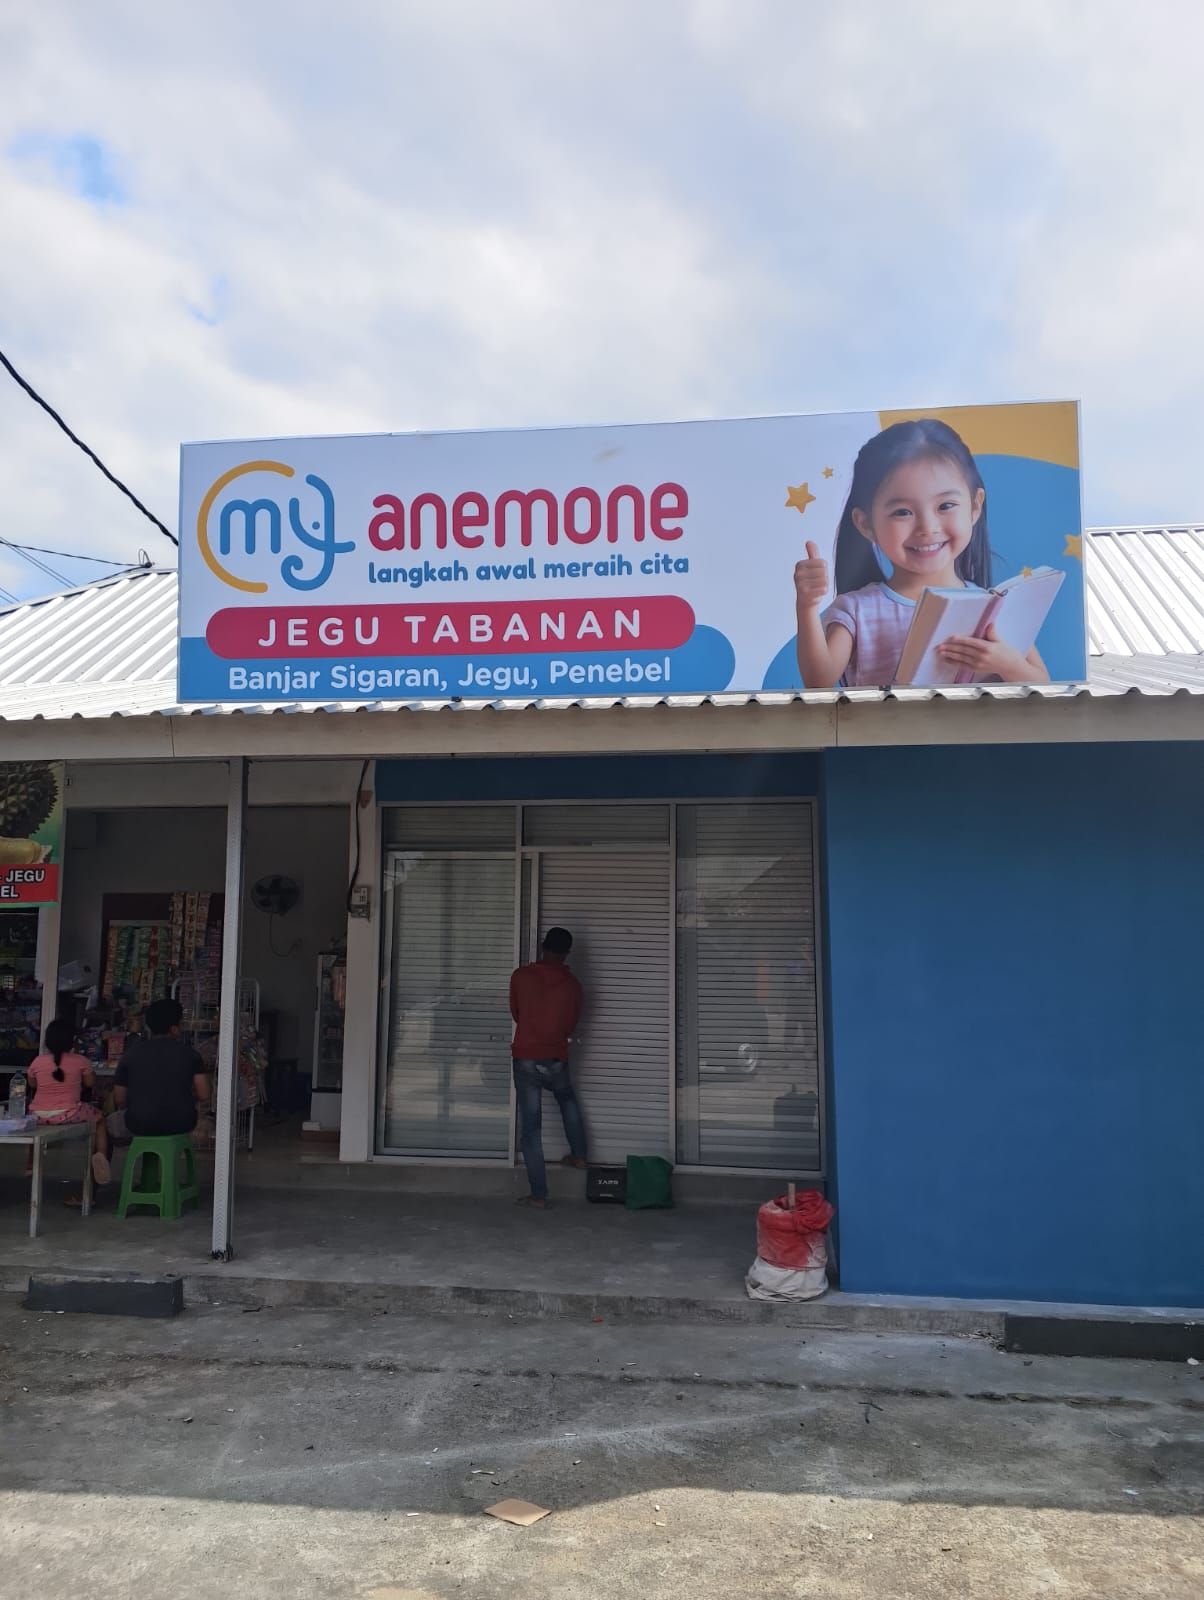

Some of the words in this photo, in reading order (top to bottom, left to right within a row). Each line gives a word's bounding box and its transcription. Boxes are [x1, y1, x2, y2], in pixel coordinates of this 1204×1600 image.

[368, 482, 689, 551] anemone
[367, 559, 468, 589] langkah
[475, 556, 536, 582] awal
[543, 553, 633, 578] meraih
[639, 552, 689, 576] cita
[257, 617, 380, 647] JEGU
[404, 609, 641, 644] TABANAN
[229, 665, 320, 694] Banjar
[330, 664, 447, 693] Sigaran,
[458, 663, 538, 691] Jegu,
[549, 656, 671, 684] Penebel
[5, 869, 45, 882] JEGU
